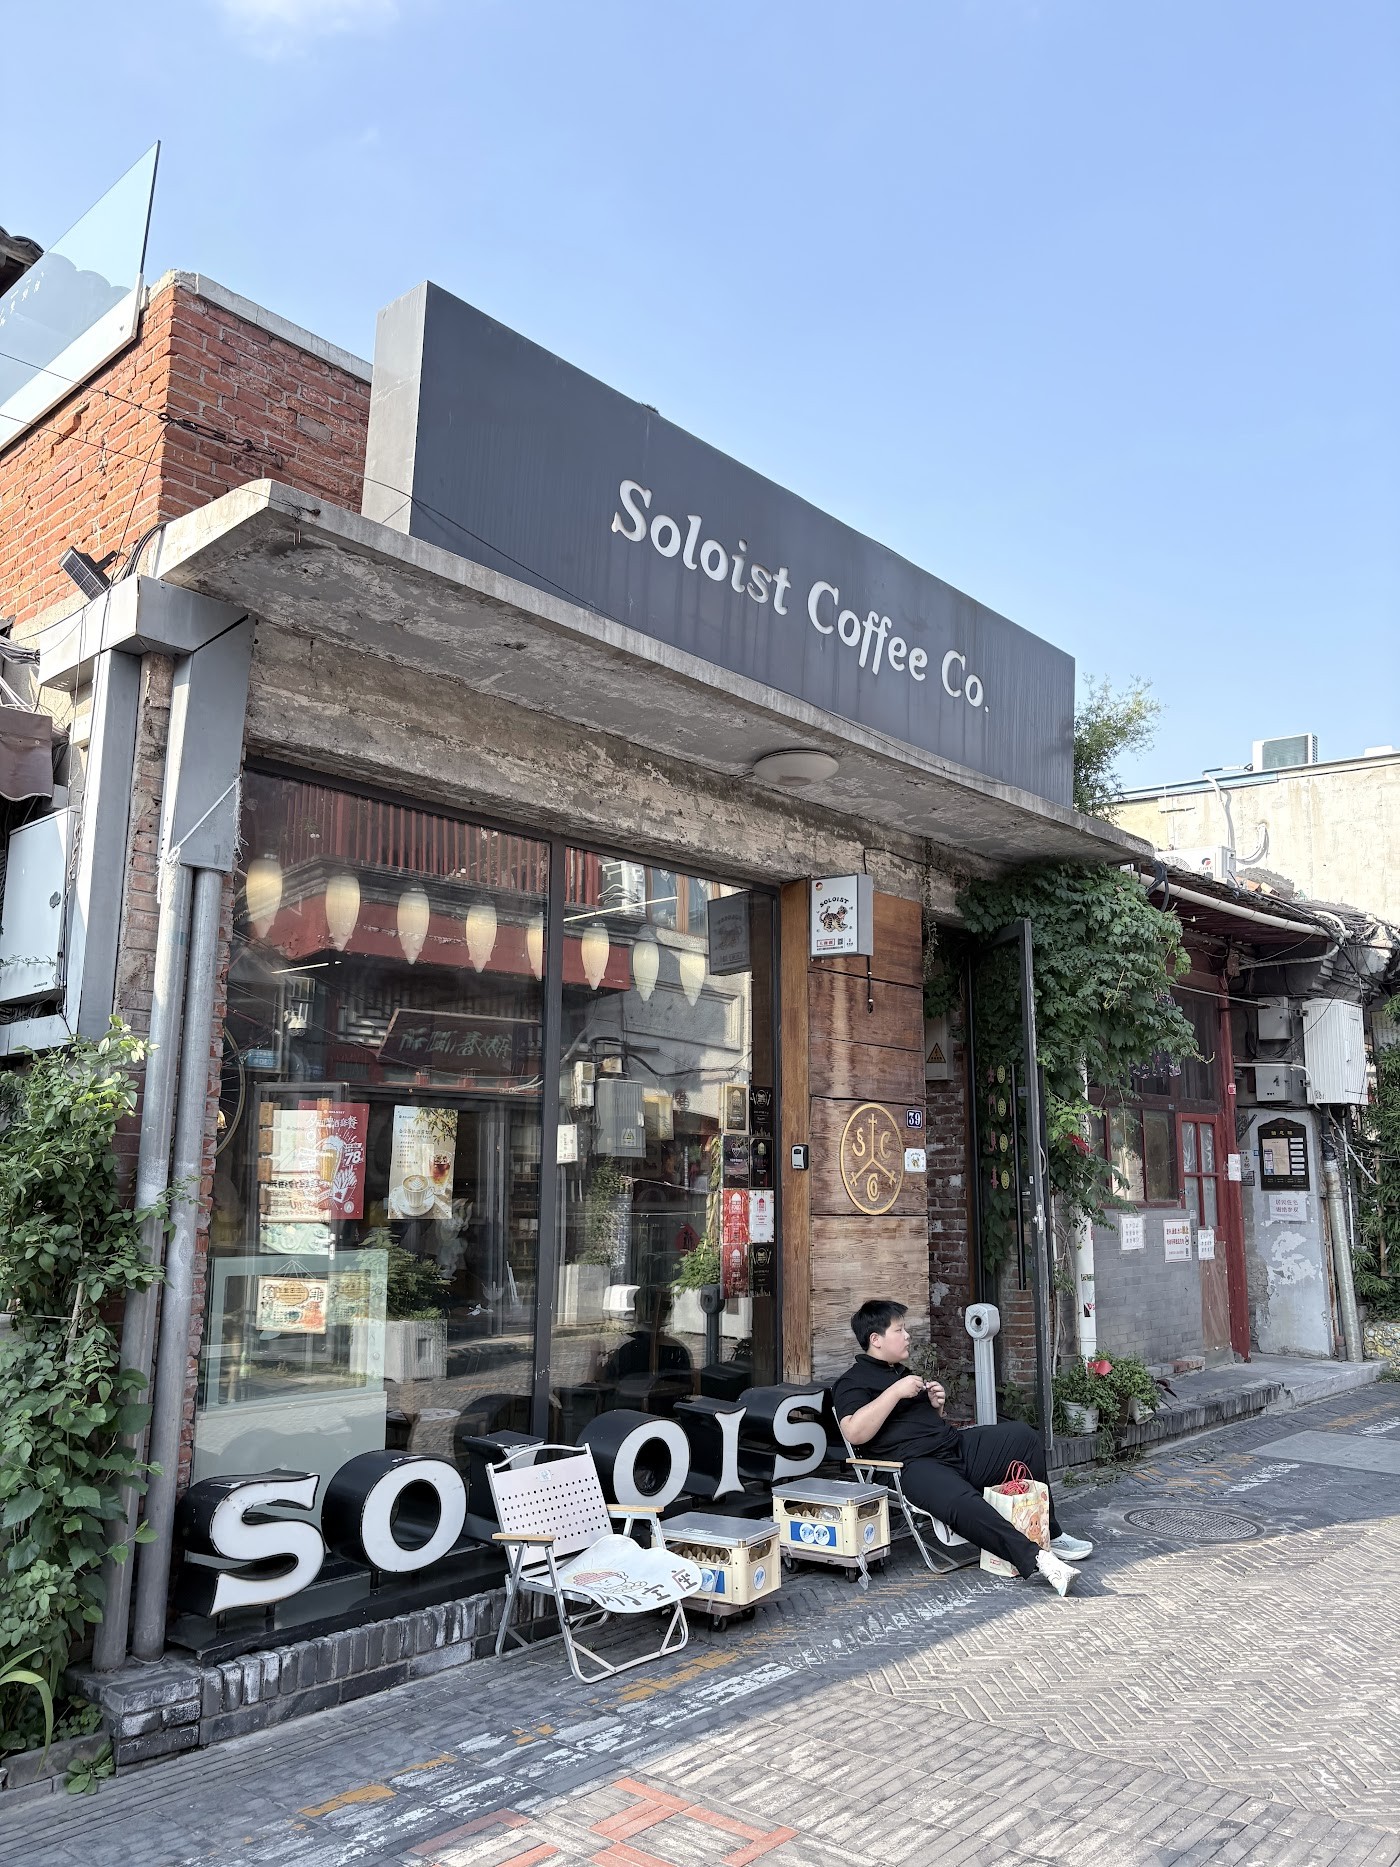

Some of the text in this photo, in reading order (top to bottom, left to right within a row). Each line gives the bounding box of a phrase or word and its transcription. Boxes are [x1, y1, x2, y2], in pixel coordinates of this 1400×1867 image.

[611, 479, 990, 713] Soloist Coffee Co.
[820, 896, 849, 908] SOLOIST
[908, 1111, 921, 1126] 39
